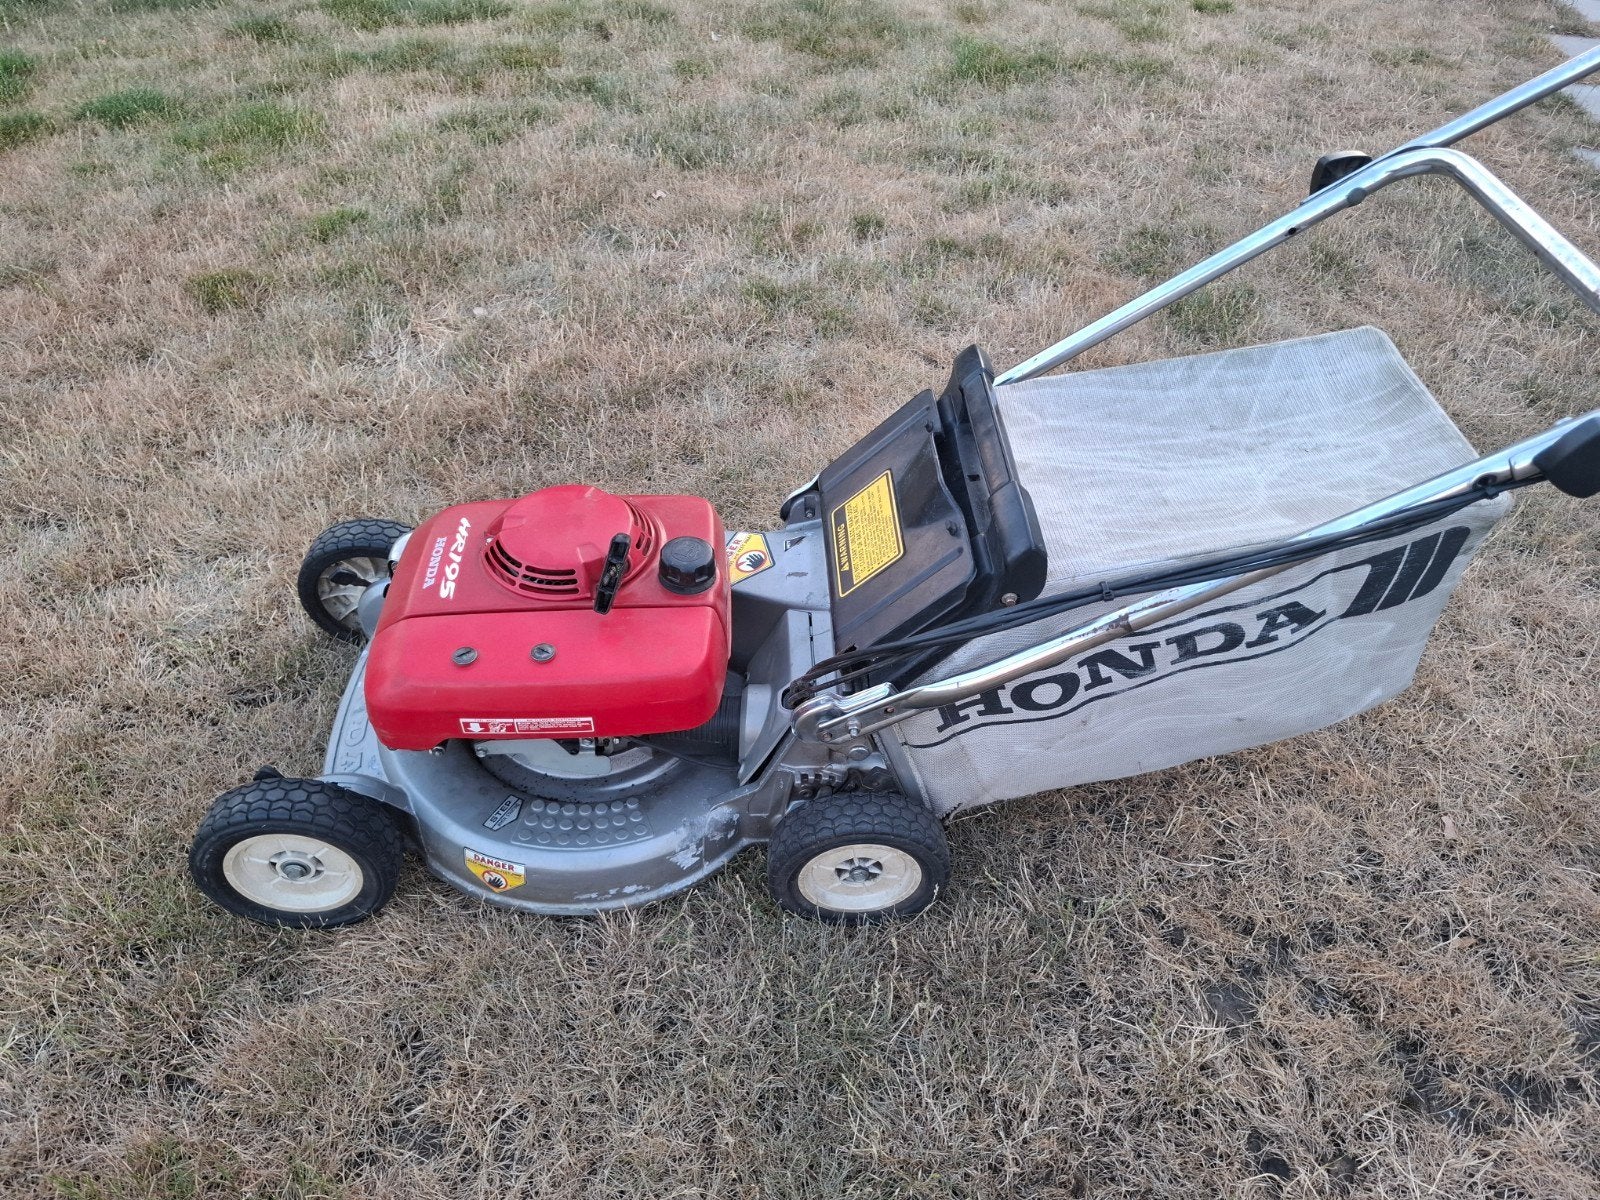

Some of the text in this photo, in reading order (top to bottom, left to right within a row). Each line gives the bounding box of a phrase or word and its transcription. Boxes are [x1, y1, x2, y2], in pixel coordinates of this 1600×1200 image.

[422, 536, 447, 590] HONDA
[439, 517, 471, 600] HR195
[837, 523, 848, 562] WARNING
[936, 599, 1327, 733] HONDA
[490, 800, 512, 823] STEP
[473, 853, 515, 872] DANGER
